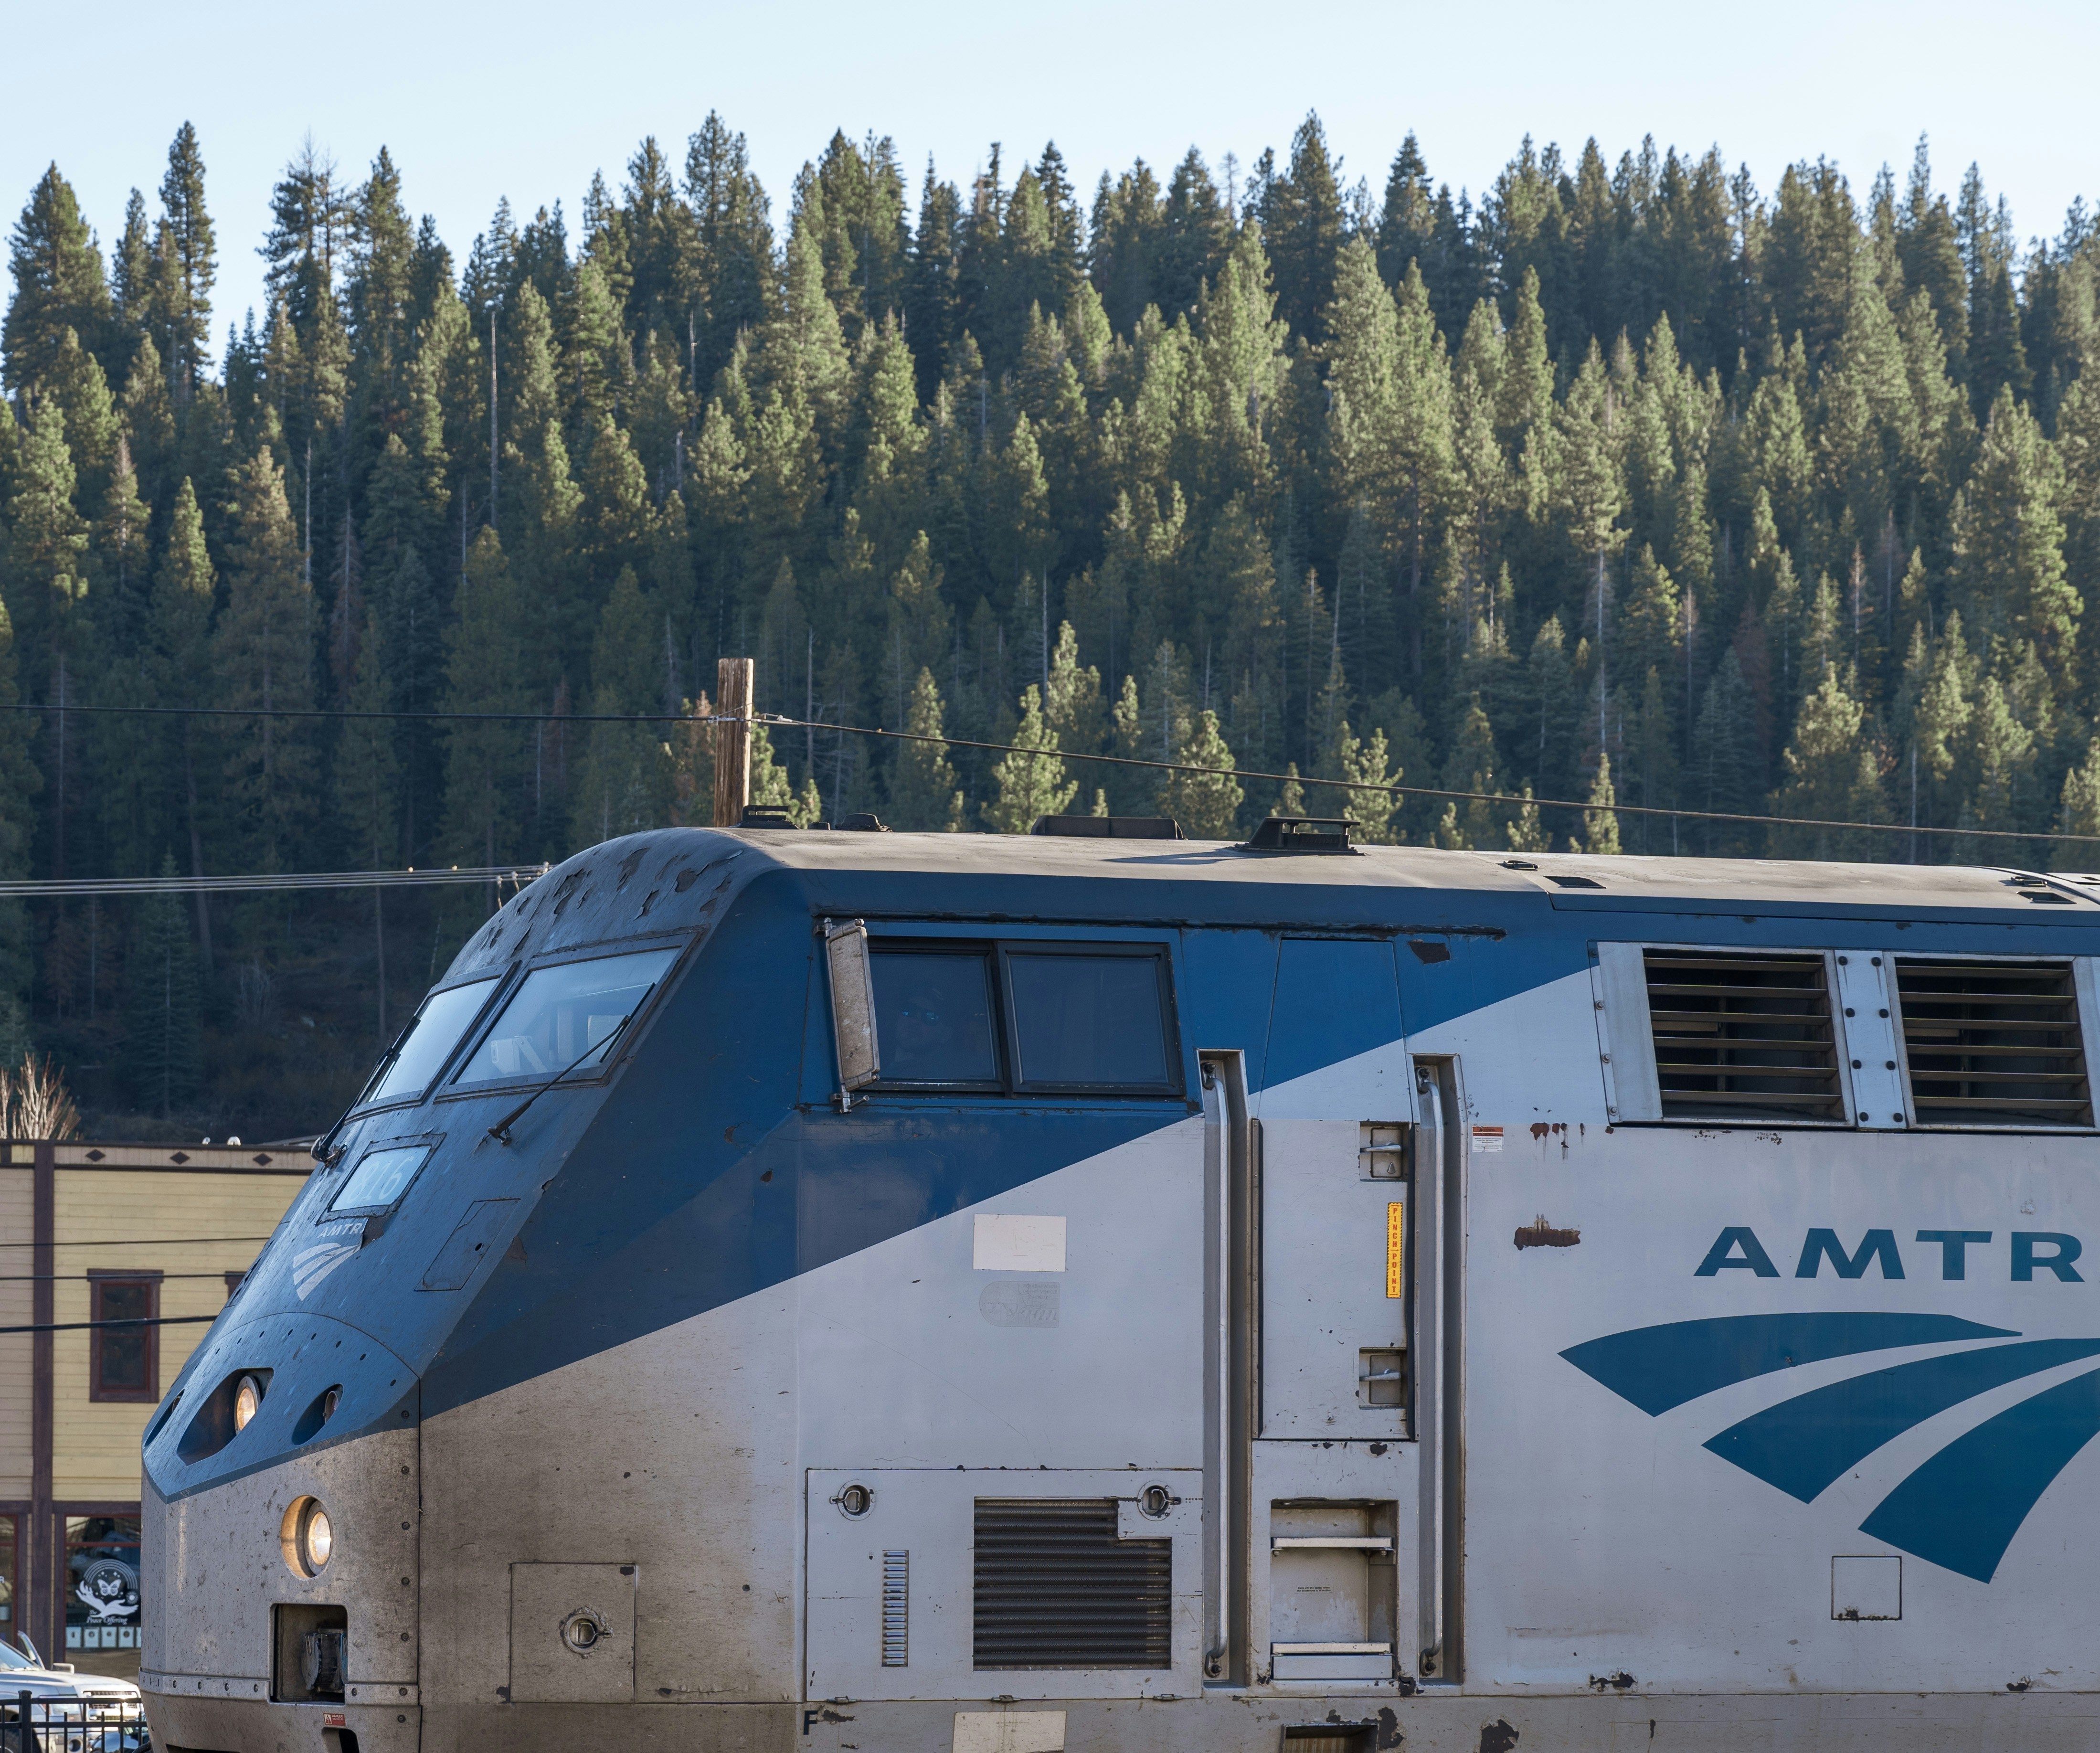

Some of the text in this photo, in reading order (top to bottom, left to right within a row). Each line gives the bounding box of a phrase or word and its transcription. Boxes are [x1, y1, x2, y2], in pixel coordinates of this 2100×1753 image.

[347, 1156, 414, 1203] 816
[317, 1222, 363, 1238] AMTR
[104, 1615, 128, 1625] Offering
[804, 1710, 818, 1735] F
